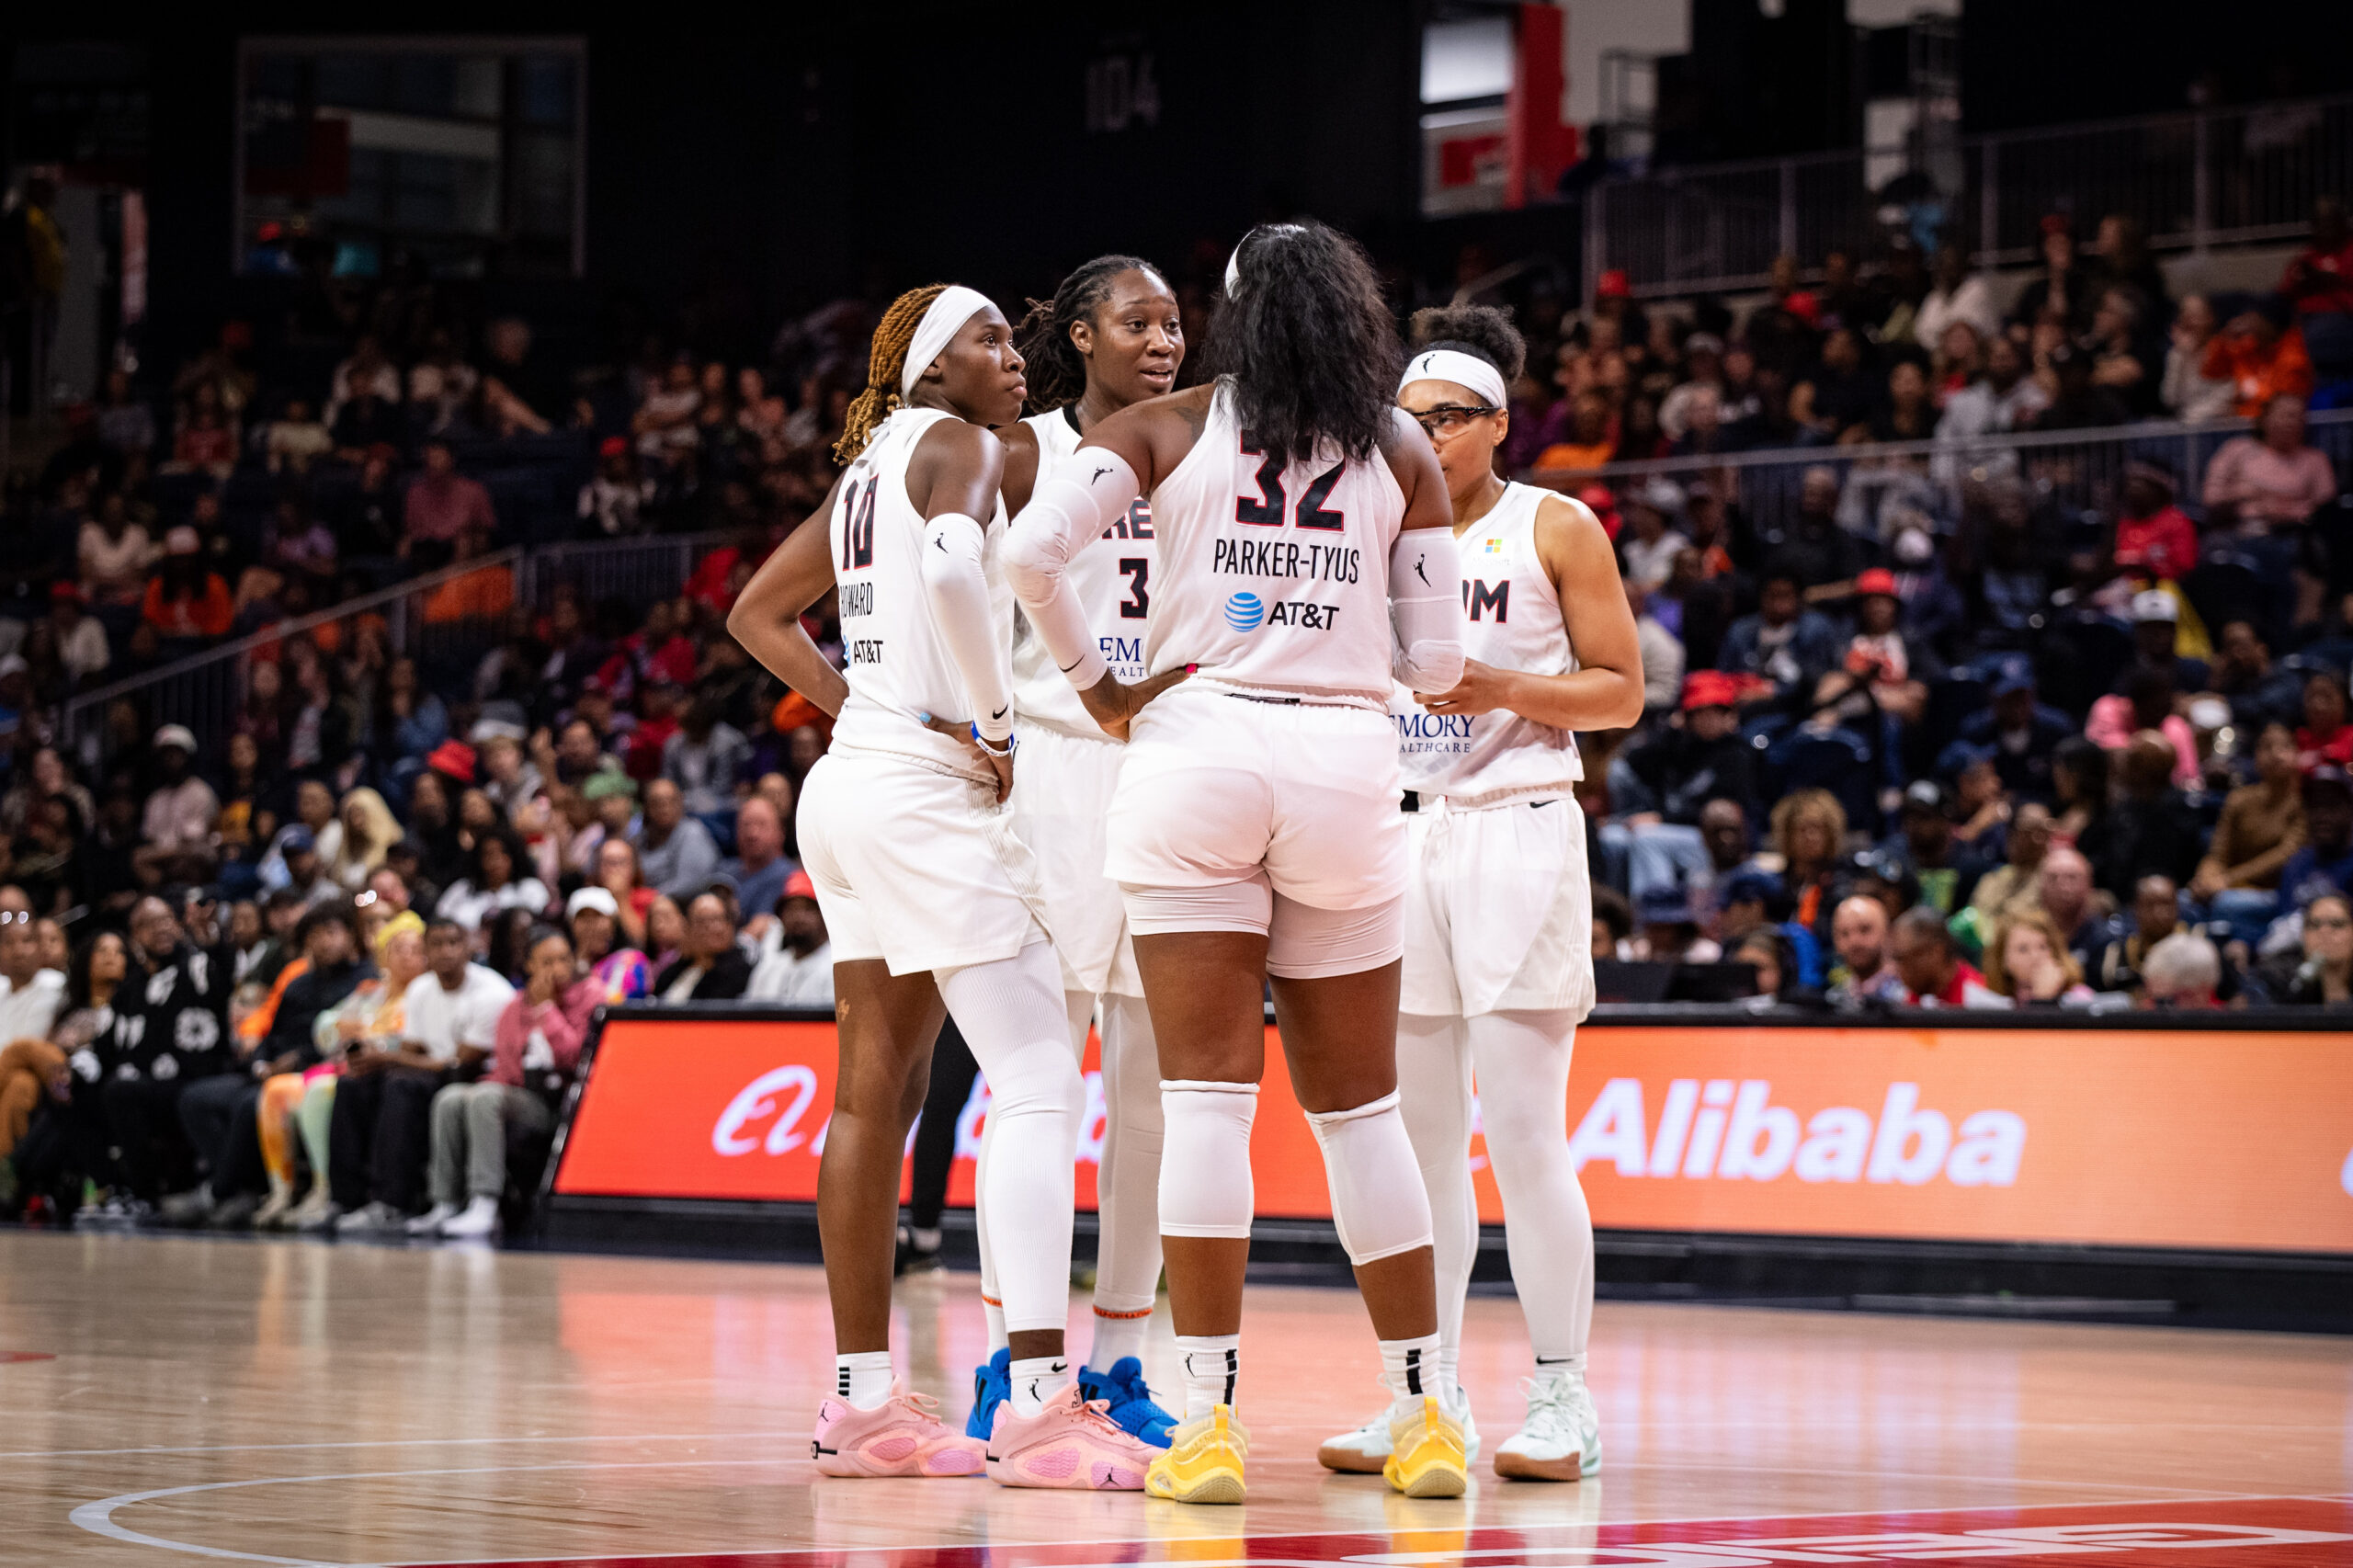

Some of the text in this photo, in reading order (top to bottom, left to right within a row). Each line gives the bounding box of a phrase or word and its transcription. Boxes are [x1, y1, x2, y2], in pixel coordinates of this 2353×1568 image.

[1086, 53, 1159, 131] 104
[1236, 429, 1346, 532] 32
[844, 473, 879, 572] 10
[1213, 539, 1359, 585] PARKER-TYUS
[1267, 601, 1340, 631] AT&T
[854, 640, 883, 664] AT&T
[1566, 1077, 2028, 1187] Alibaba
[1022, 1522, 2351, 1568] GEIC
